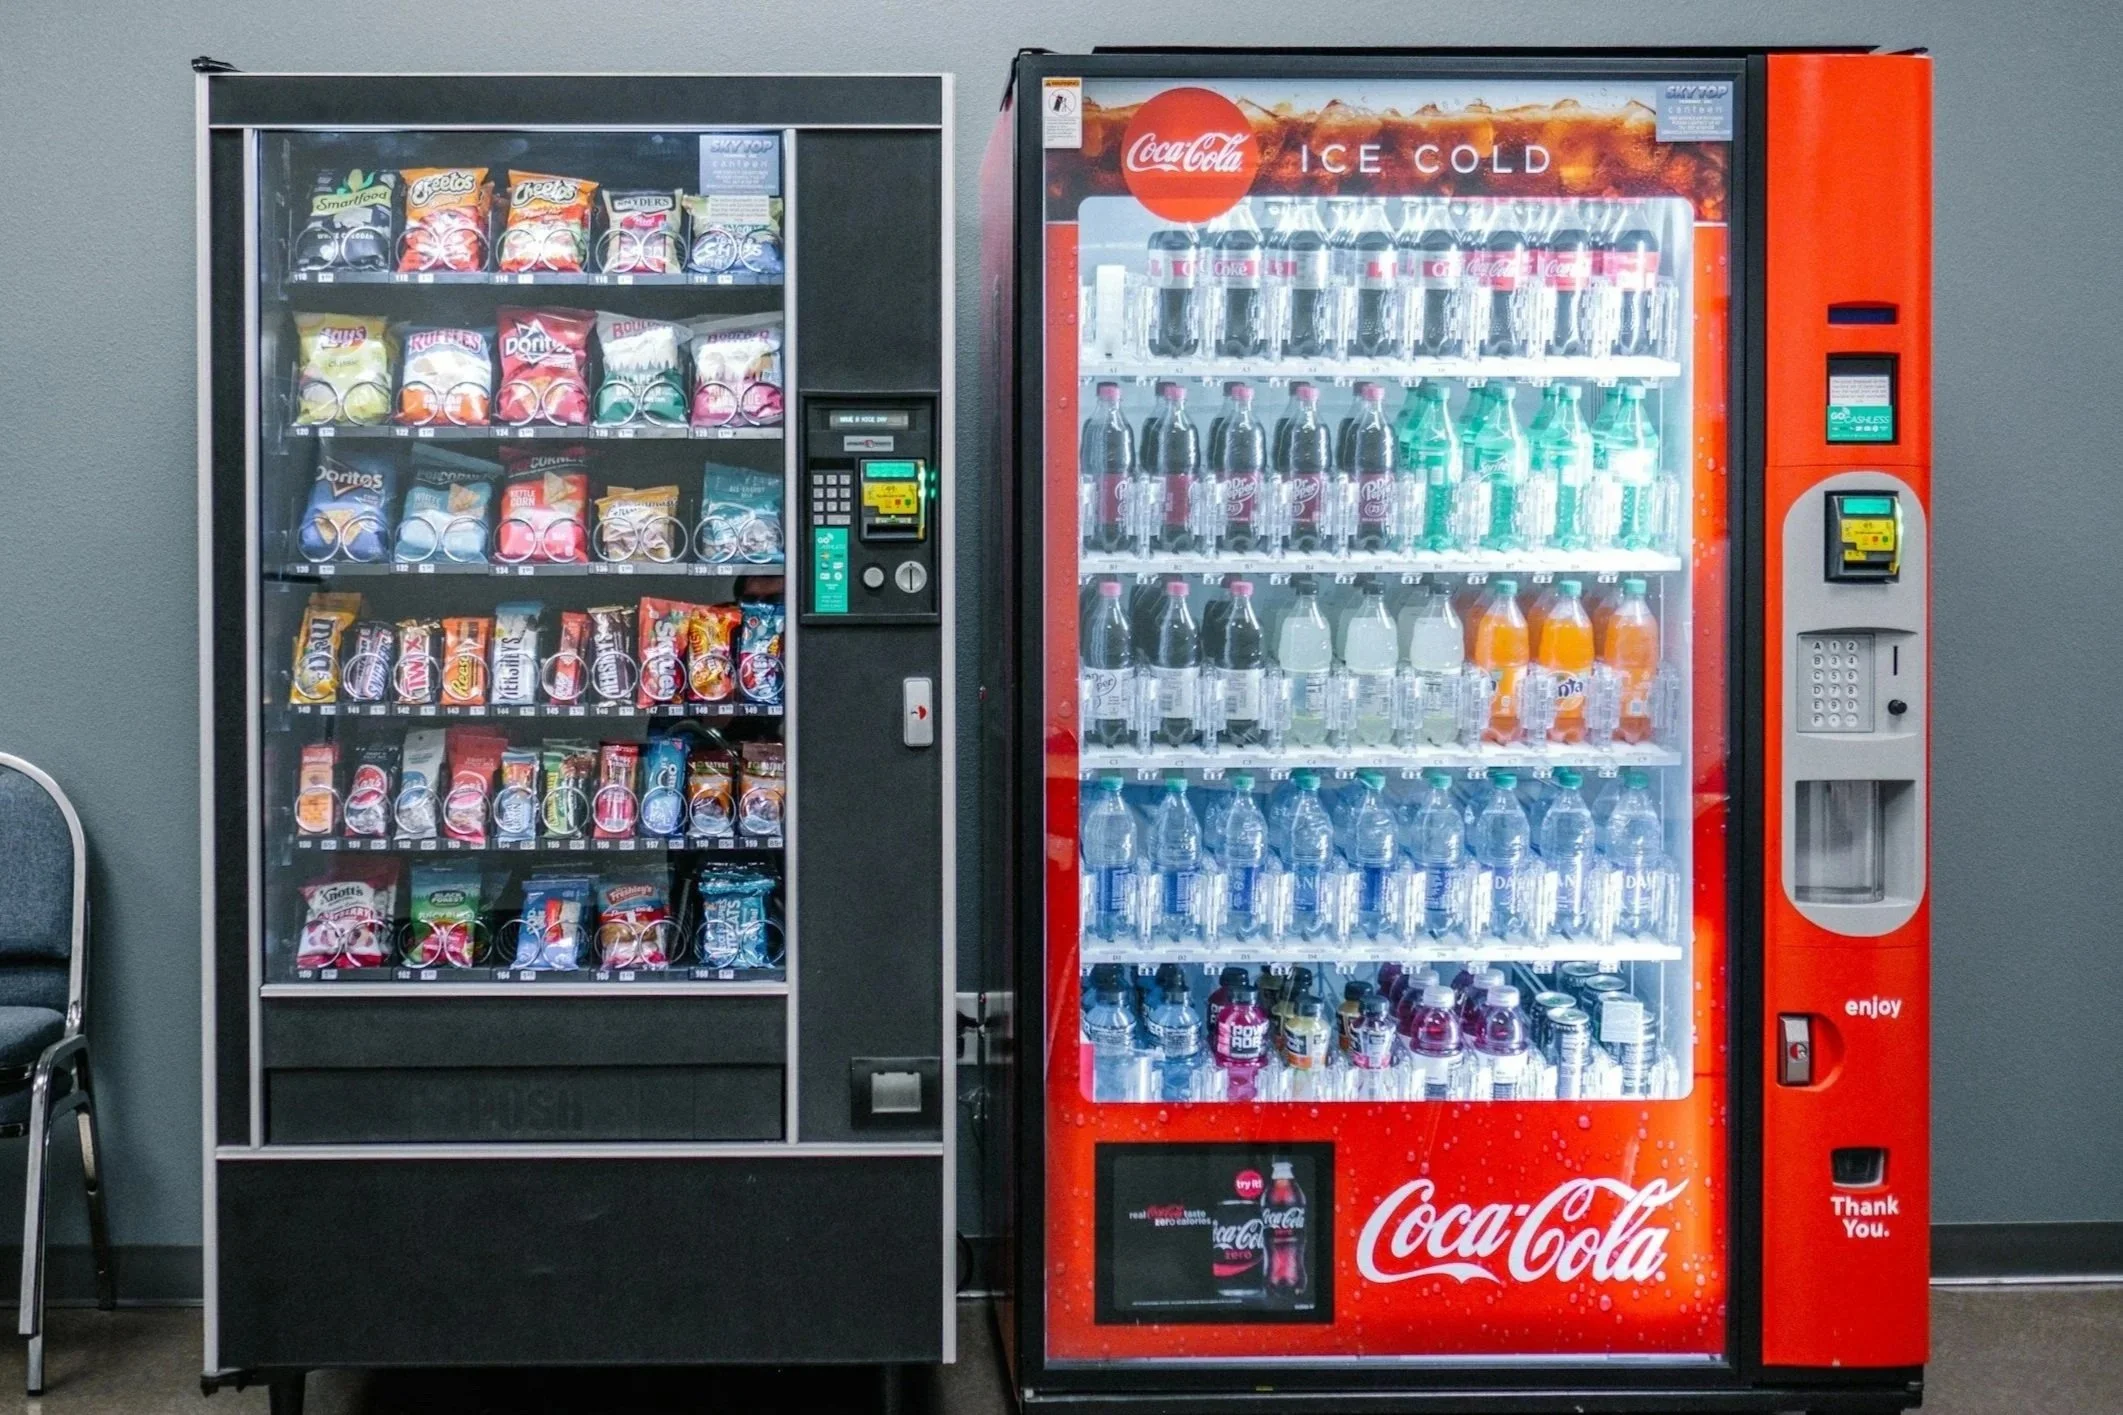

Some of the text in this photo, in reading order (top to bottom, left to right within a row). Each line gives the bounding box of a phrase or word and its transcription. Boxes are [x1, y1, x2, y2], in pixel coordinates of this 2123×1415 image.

[1126, 132, 1250, 173] Coca-Cola
[1302, 144, 1550, 174] ICE COLD
[411, 172, 477, 207] Cheetos
[512, 179, 579, 209] Cheetos
[316, 190, 388, 212] Smartfood
[1214, 260, 1248, 277] Coke
[320, 327, 367, 348] Lay's
[1831, 412, 1845, 420] GO
[1844, 415, 1890, 424] CASHLESS
[316, 465, 383, 489] Doritos
[511, 490, 536, 498] KETTLE
[511, 498, 536, 507] CORN
[367, 634, 393, 699] SNICKERS
[404, 637, 430, 696] TWIX
[323, 885, 364, 903] Knott's
[609, 885, 653, 901] Freshley's
[418, 912, 445, 920] JUICY
[1845, 996, 1902, 1019] enjoy
[1236, 1179, 1263, 1190] try it!
[1129, 1210, 1146, 1220] real
[1184, 1210, 1207, 1218] taste
[1830, 1196, 1900, 1216] Thank
[1154, 1217, 1211, 1227] zero calories
[1356, 1177, 1691, 1284] Coca-Cola
[1843, 1218, 1890, 1239] You.
[1213, 1219, 1264, 1250] ca-Col
[1225, 1251, 1253, 1260] zero
